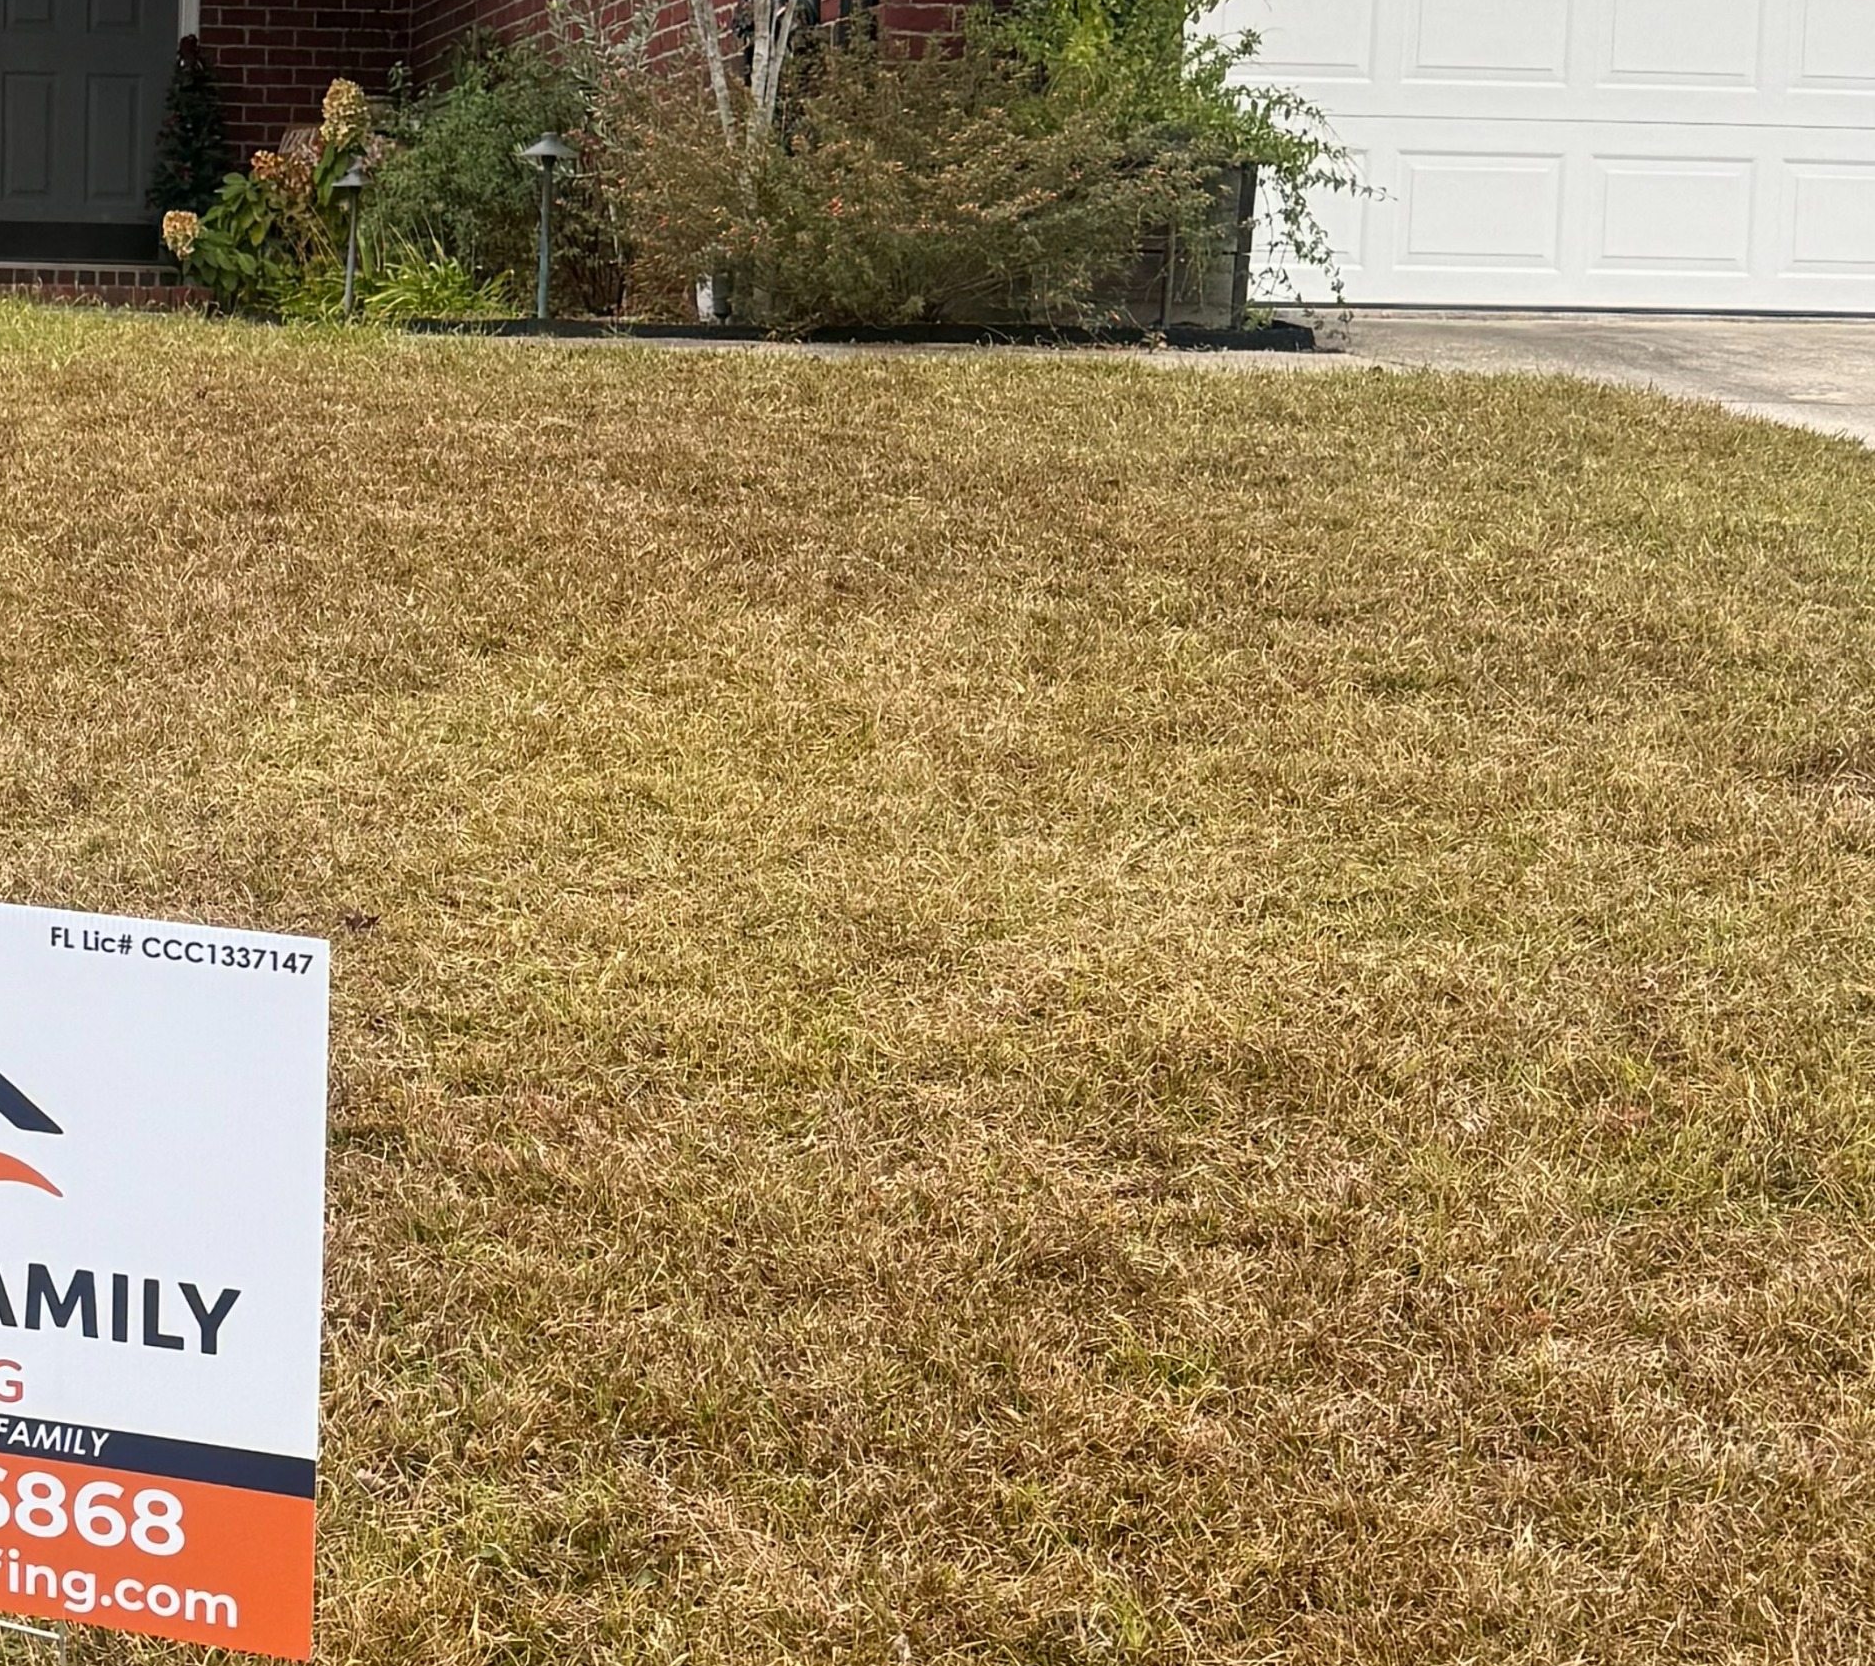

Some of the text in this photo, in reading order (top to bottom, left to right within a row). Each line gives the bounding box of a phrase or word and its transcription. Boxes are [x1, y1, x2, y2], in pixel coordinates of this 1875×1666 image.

[50, 926, 313, 974] FL Lic# CCC1337147
